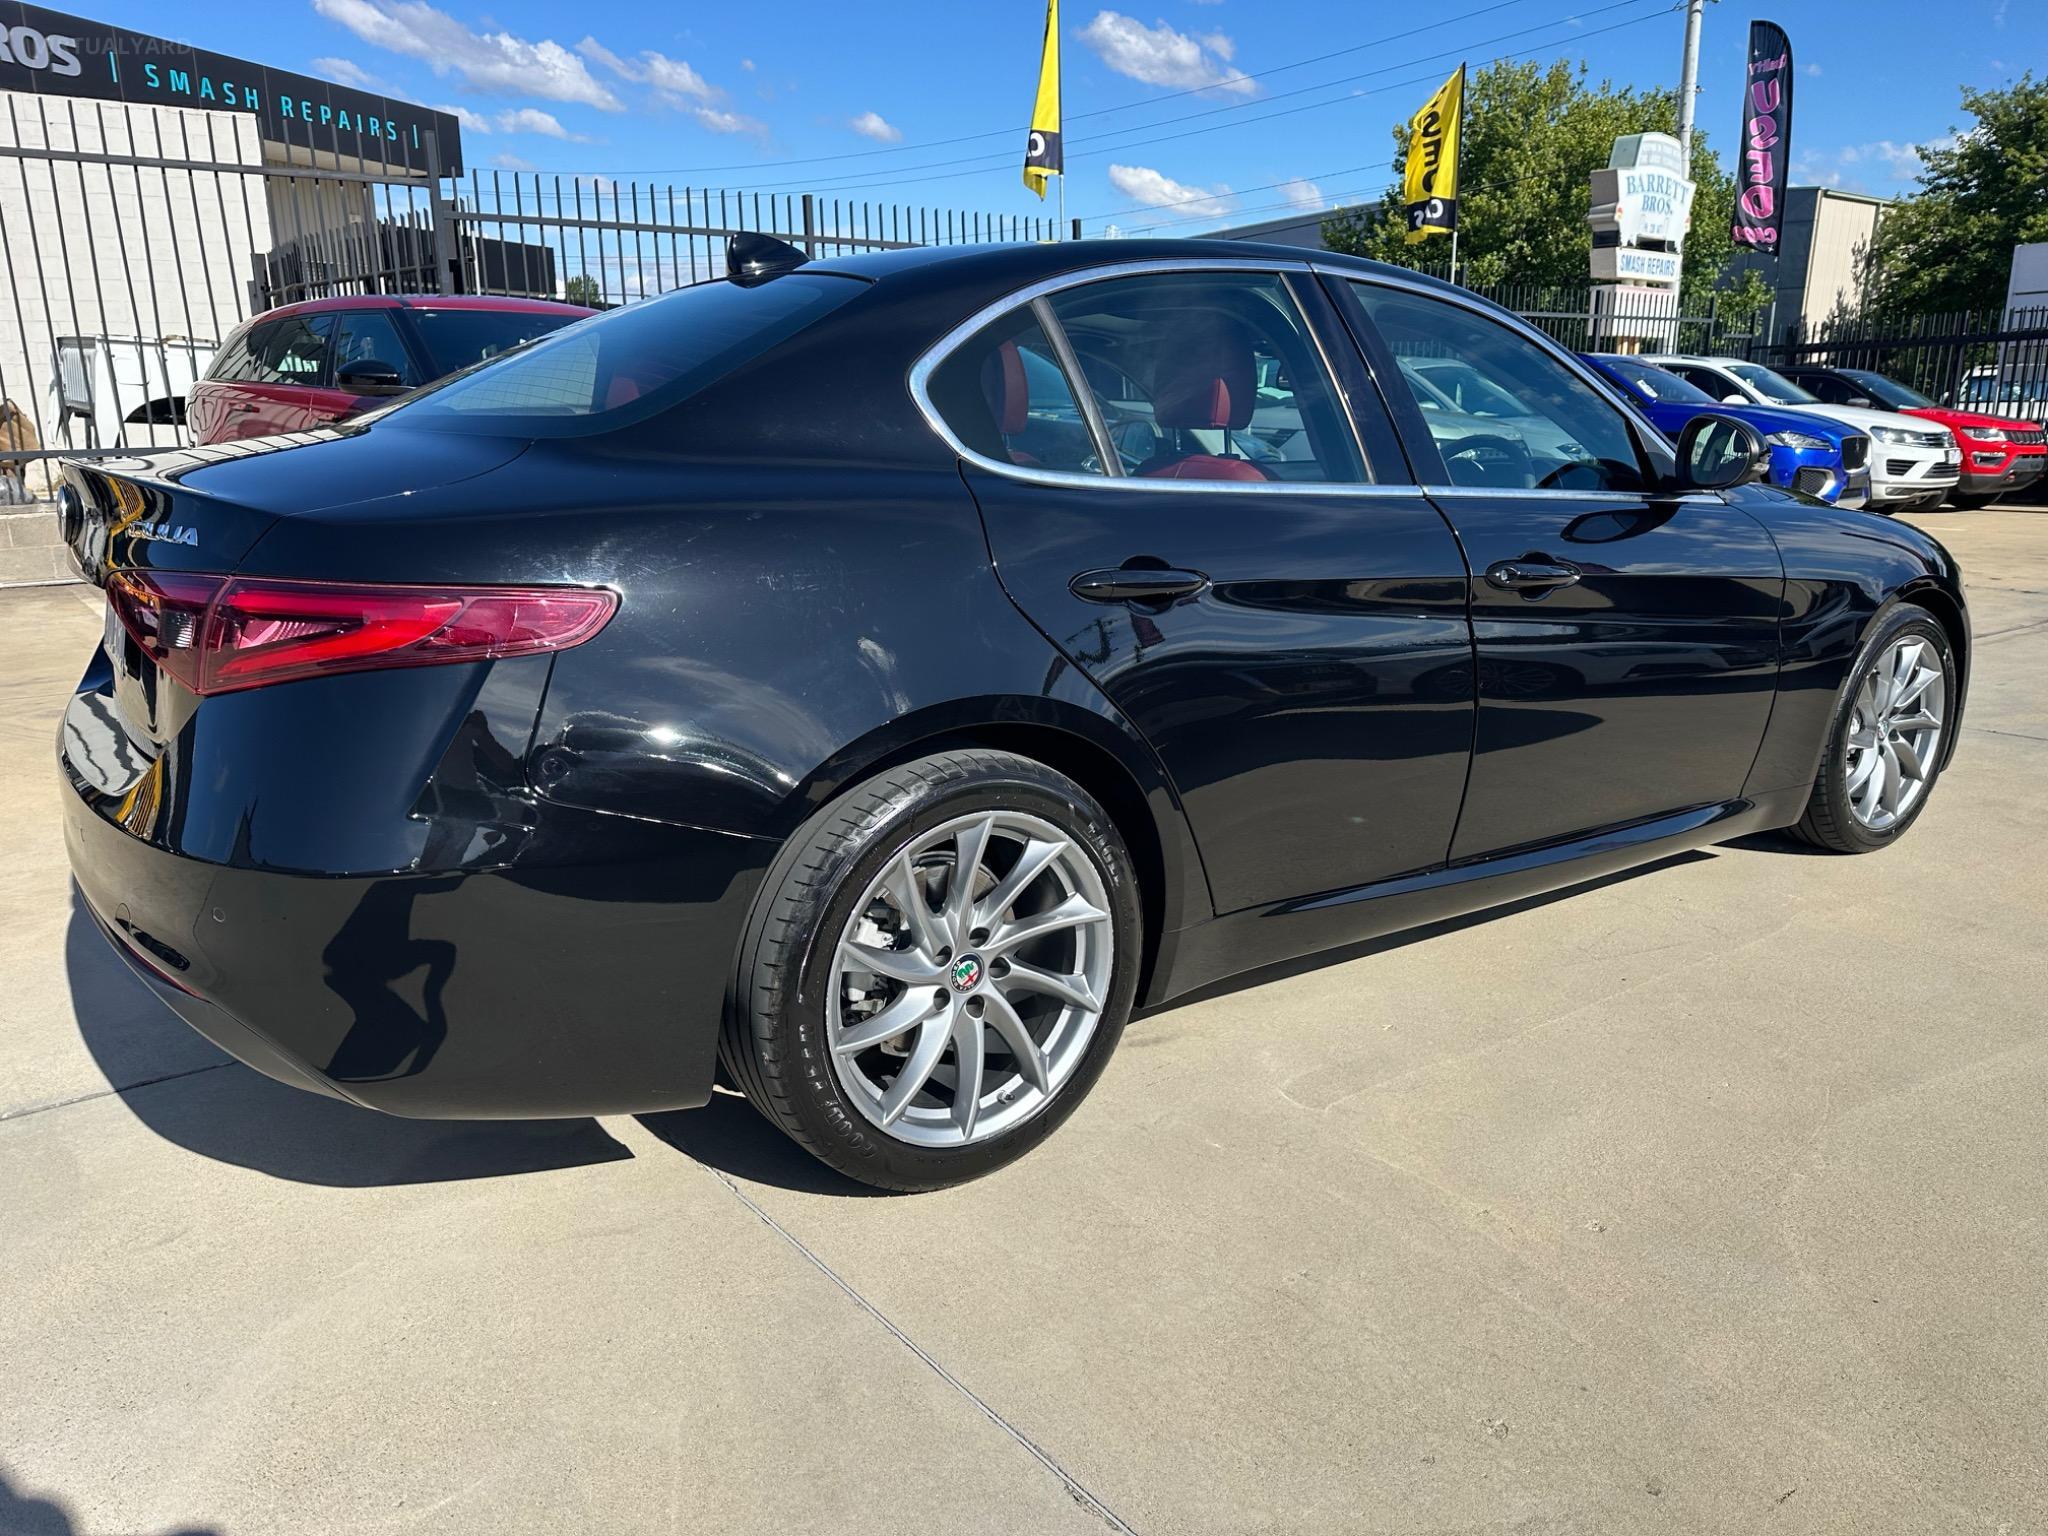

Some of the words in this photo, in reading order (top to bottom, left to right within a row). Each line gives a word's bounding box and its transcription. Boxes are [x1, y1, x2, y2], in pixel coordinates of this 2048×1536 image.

[144, 63, 259, 110] SMASH
[281, 95, 397, 141] REPAIRS
[1626, 174, 1689, 204] BARRETT
[1642, 195, 1673, 215] BROS.
[1620, 254, 1646, 274] SMASH
[1646, 257, 1676, 277] REPAIRS
